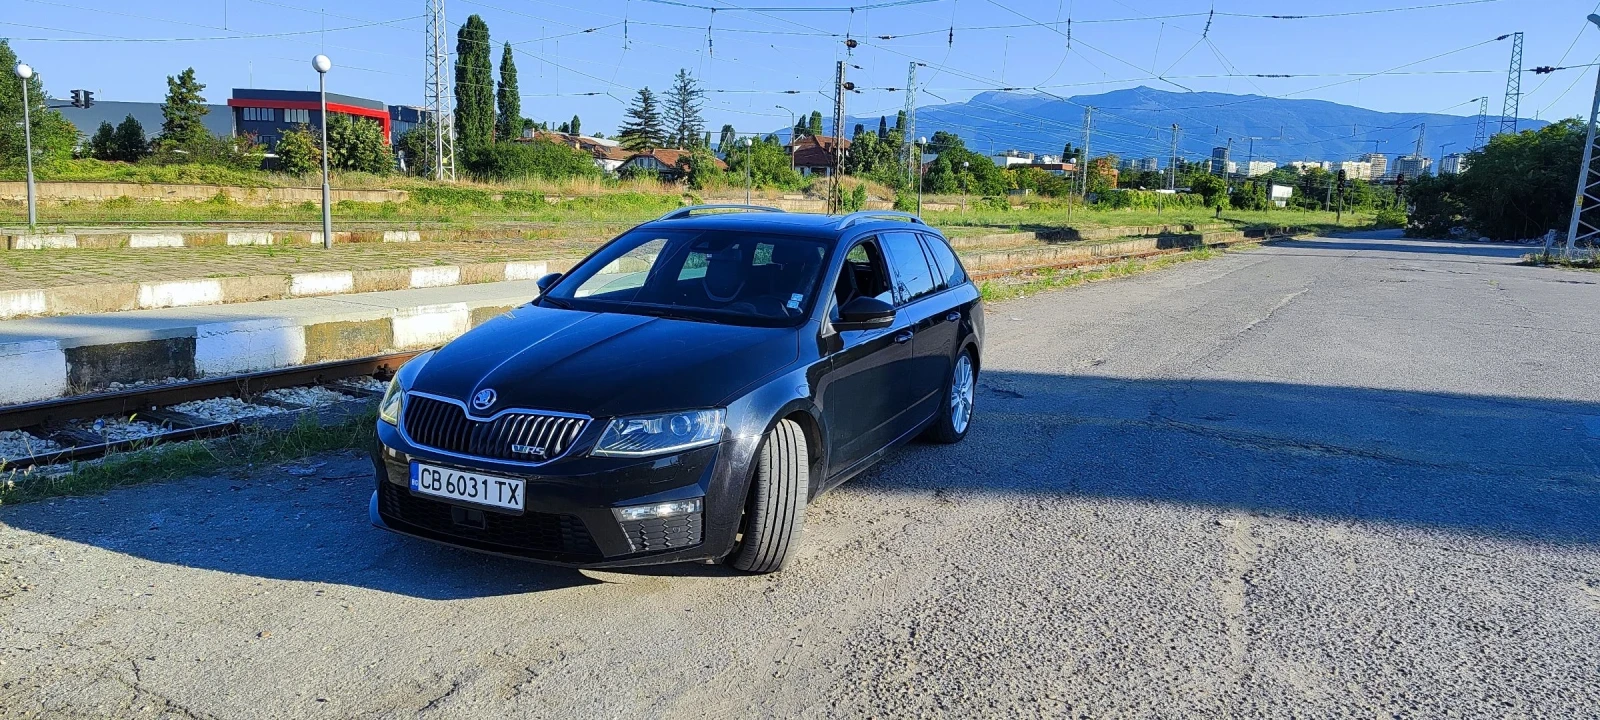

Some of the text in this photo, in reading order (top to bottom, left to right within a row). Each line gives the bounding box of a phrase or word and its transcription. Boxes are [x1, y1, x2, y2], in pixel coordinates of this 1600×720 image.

[421, 468, 519, 505] CB 6031 TX
